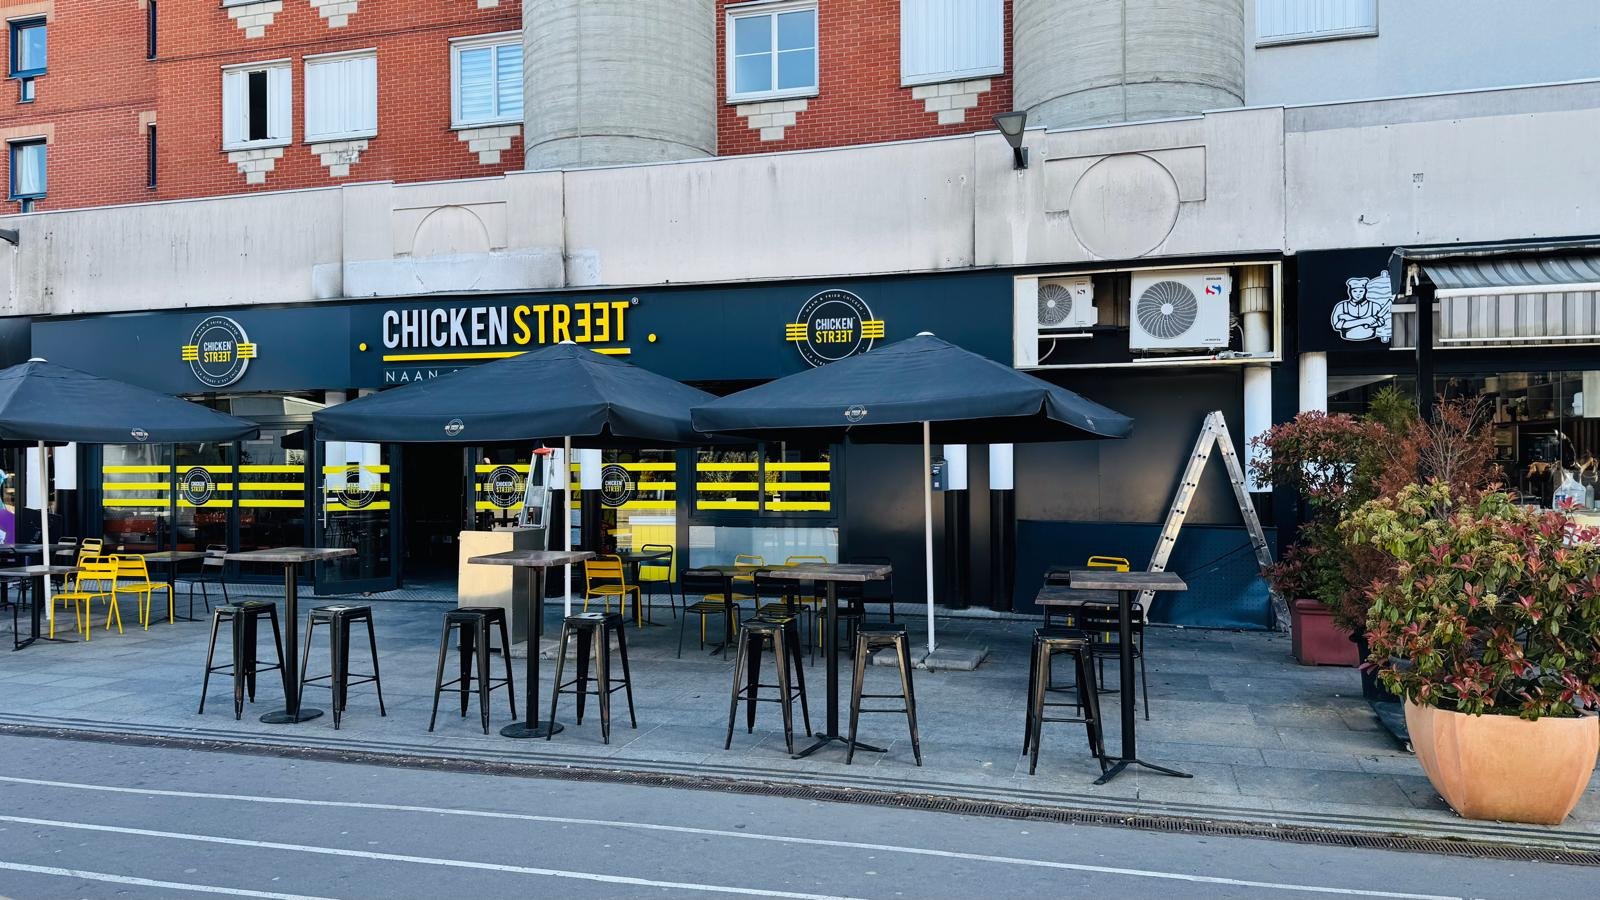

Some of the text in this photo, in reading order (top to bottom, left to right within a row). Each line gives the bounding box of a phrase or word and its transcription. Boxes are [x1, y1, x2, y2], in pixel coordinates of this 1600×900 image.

[382, 306, 508, 349] CHICKEN
[815, 317, 853, 330] CHICKEN
[203, 341, 232, 351] CHICKEN
[386, 370, 438, 382] NAAN
